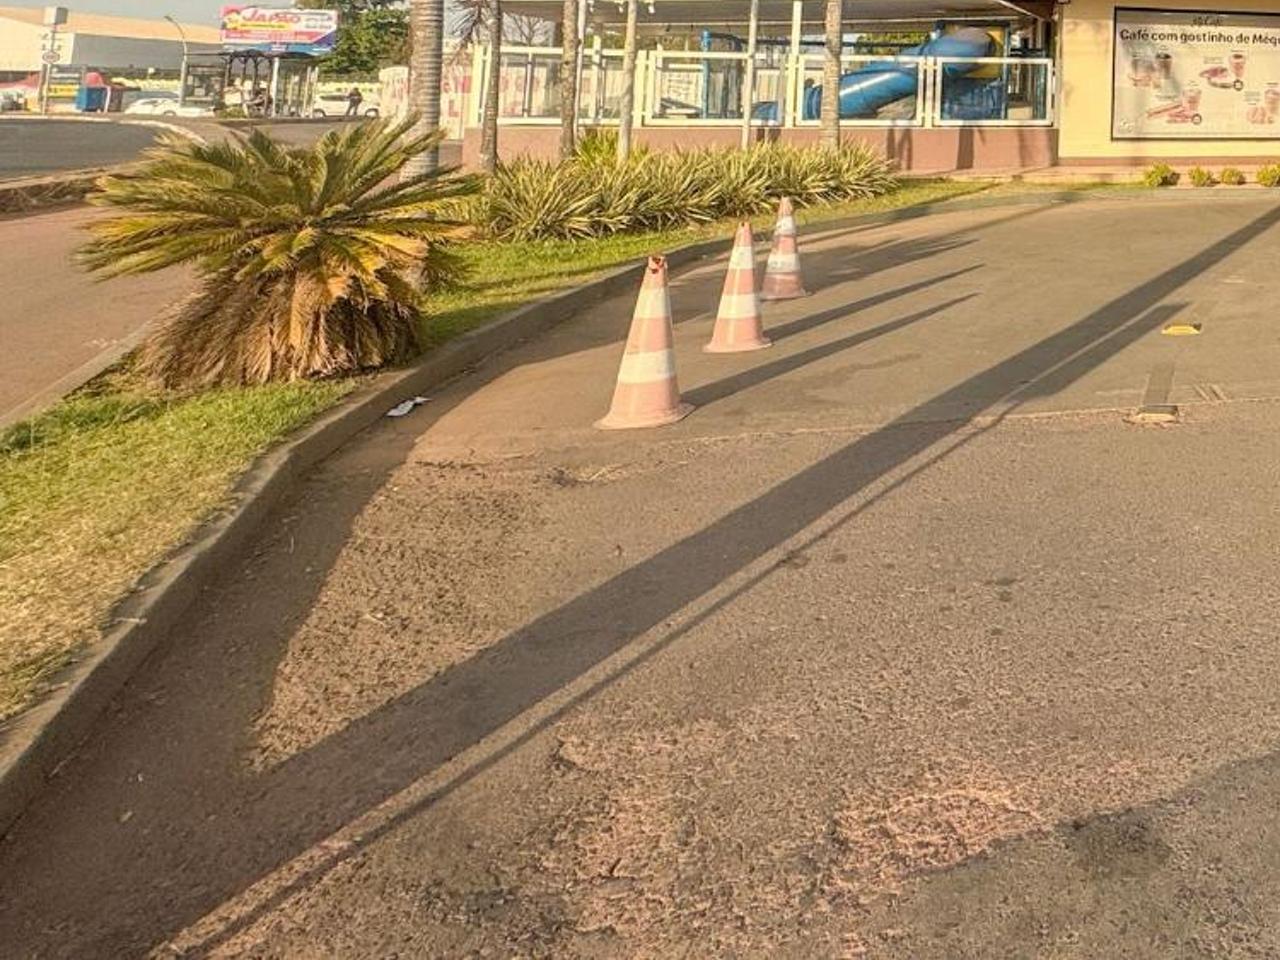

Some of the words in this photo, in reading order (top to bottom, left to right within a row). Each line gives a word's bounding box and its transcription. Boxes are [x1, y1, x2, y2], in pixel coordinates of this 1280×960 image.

[1119, 28, 1149, 41] Café
[1151, 30, 1178, 42] com
[1180, 29, 1234, 45] gostinho
[1235, 32, 1250, 45] de
